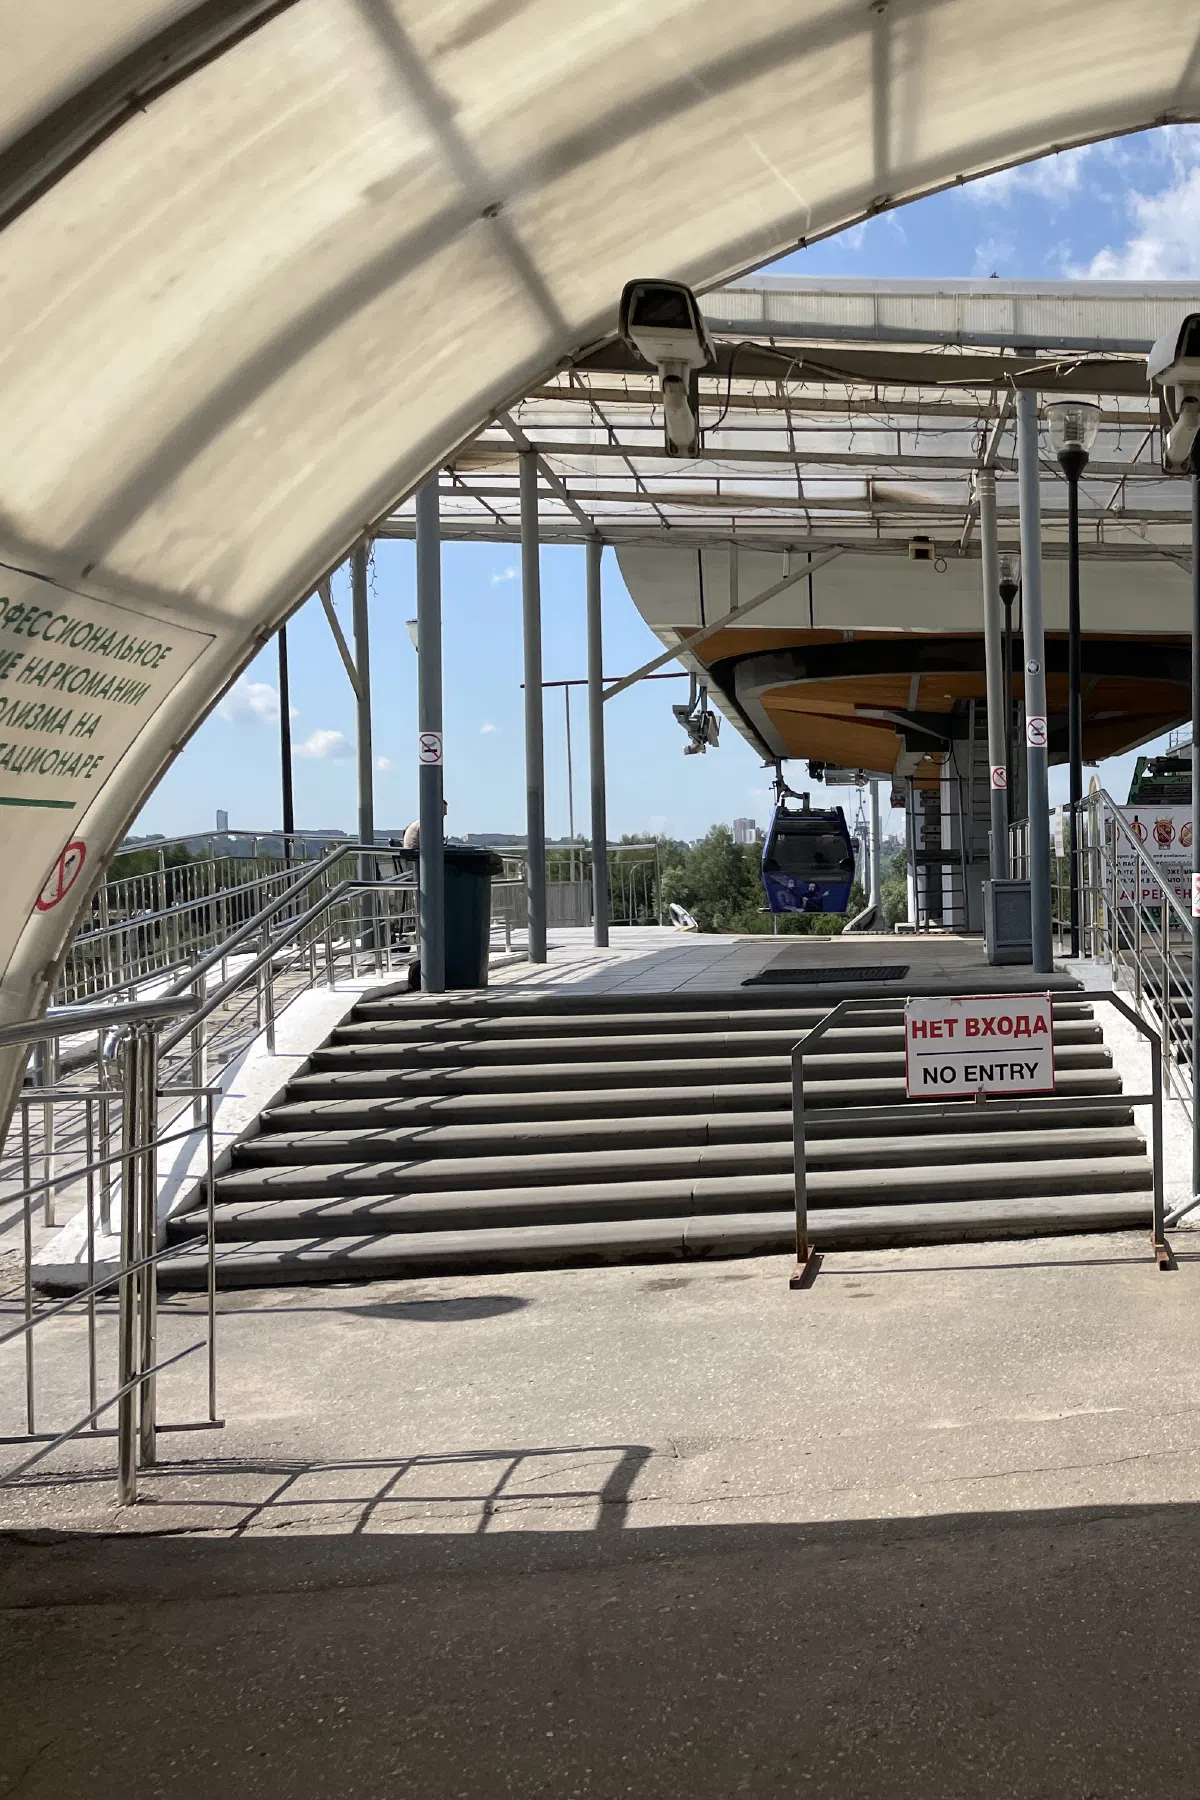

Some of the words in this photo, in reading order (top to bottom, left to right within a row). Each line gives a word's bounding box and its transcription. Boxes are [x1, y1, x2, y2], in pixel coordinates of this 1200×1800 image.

[15, 656, 152, 706] НАРКОМАНИИ
[69, 712, 103, 739] НА
[911, 1018, 958, 1039] НЕТ
[965, 1015, 1048, 1039] ВХОДА
[923, 1066, 957, 1084] NO
[964, 1062, 1039, 1082] ENTRY
